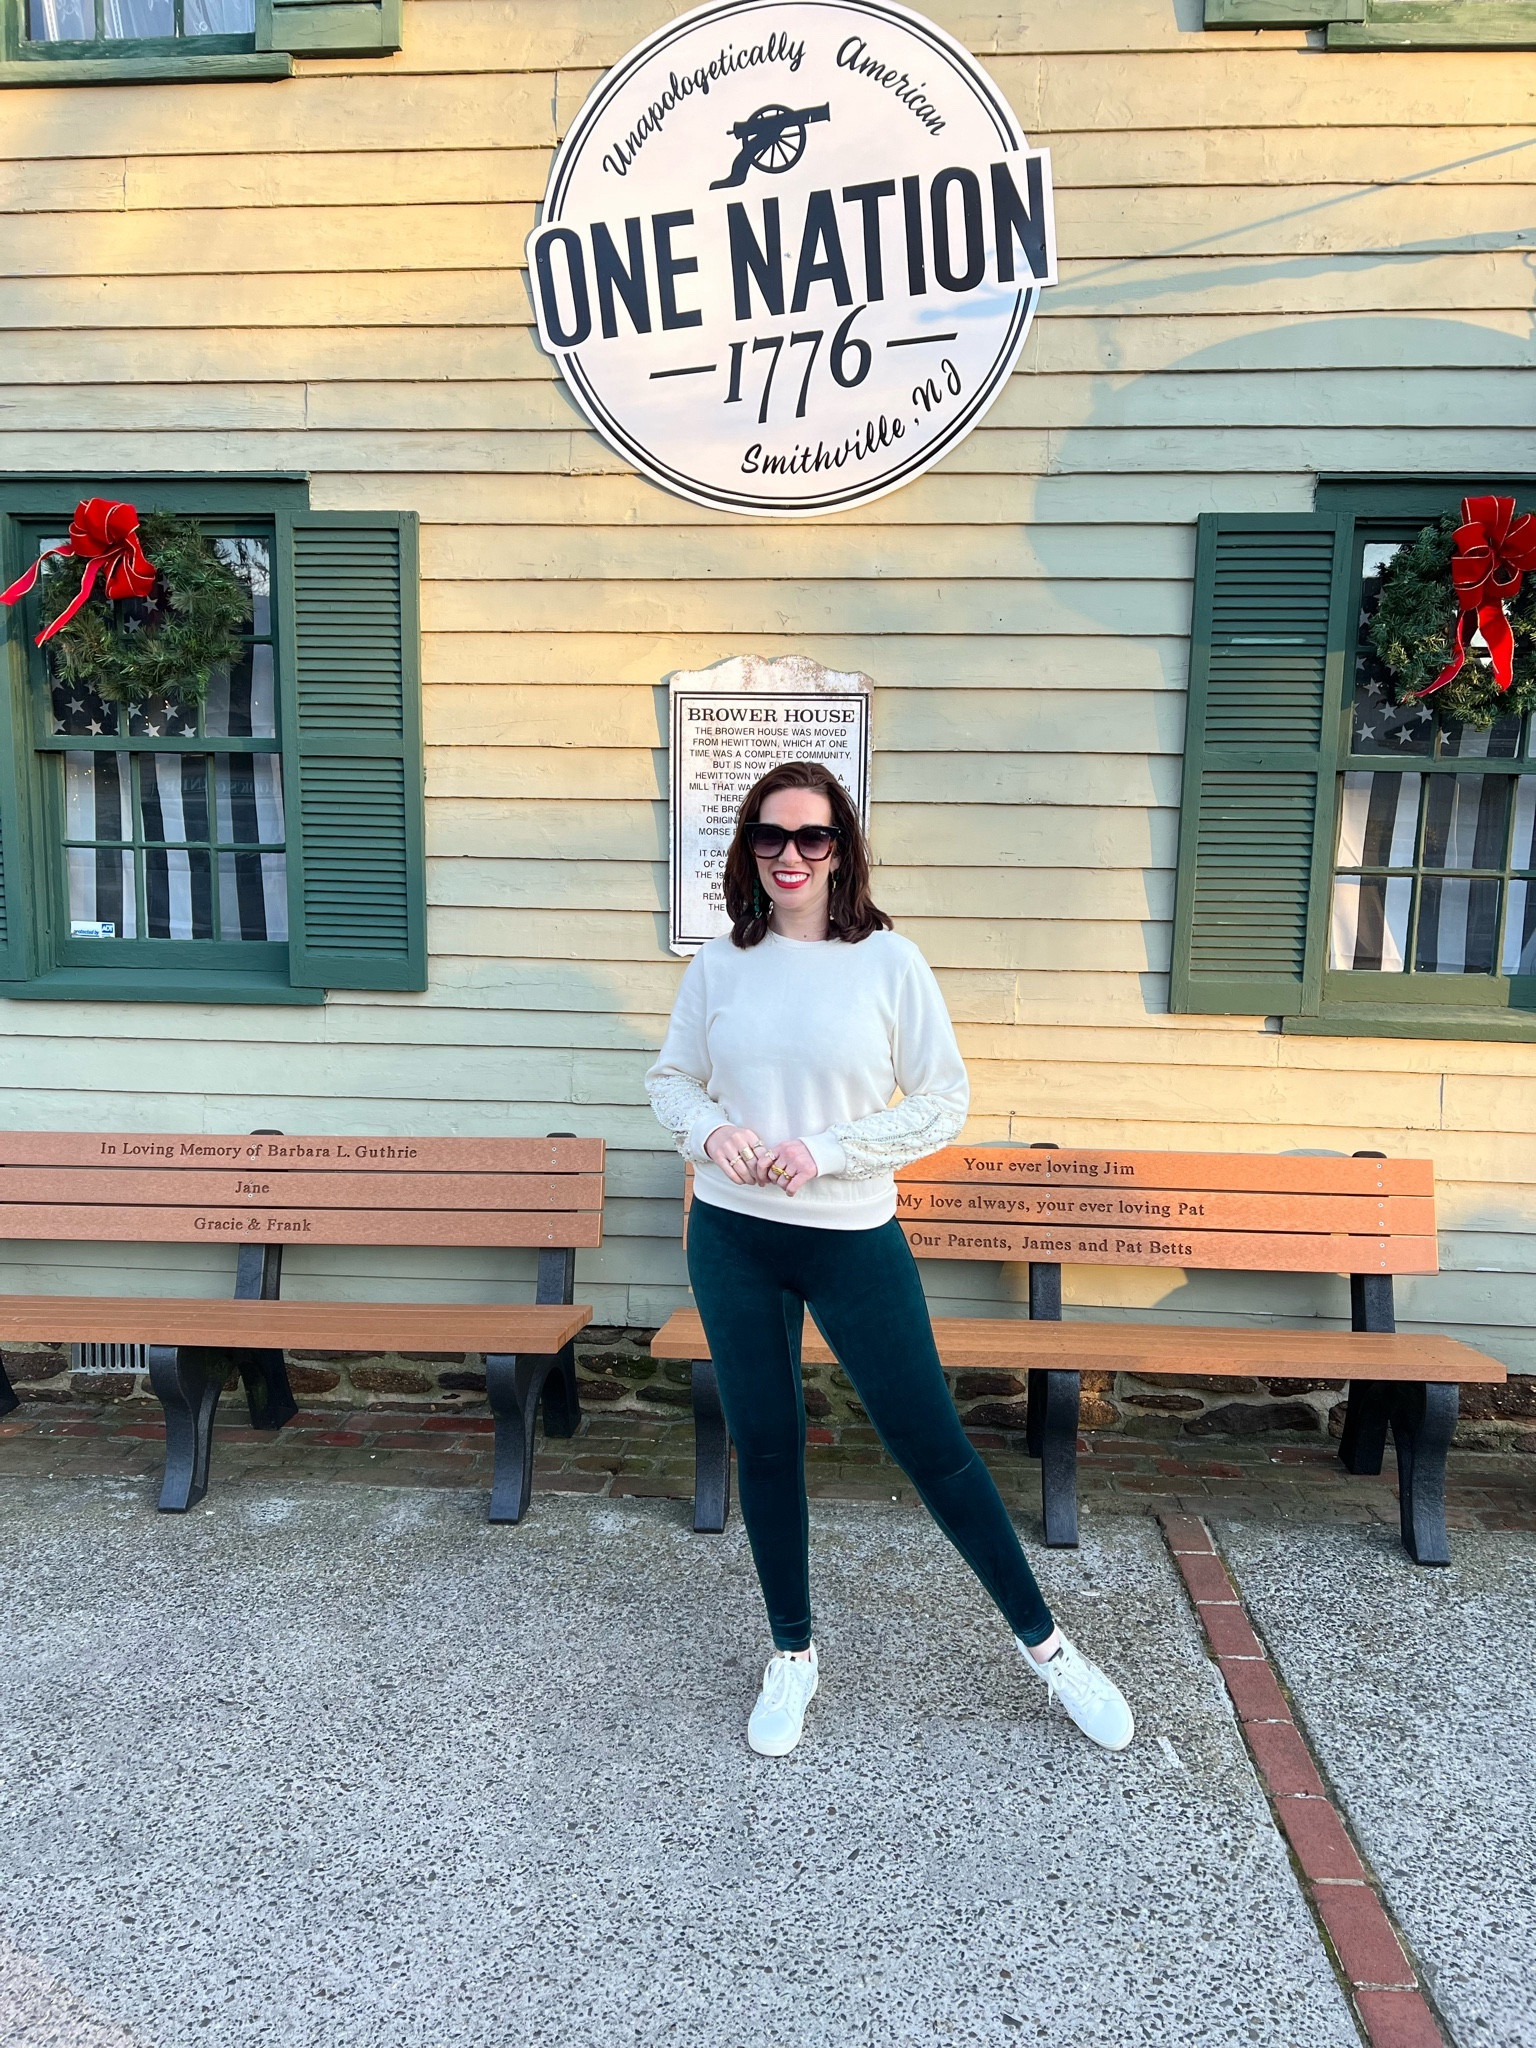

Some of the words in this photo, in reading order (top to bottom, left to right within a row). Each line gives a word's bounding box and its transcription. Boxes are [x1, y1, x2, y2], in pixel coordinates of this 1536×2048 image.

[602, 31, 806, 177] Unapologetically
[835, 36, 945, 136] American
[535, 208, 703, 347] ONE
[727, 156, 1049, 321] NATION
[724, 304, 872, 424] 1776
[688, 708, 778, 722] BROWER
[784, 709, 855, 723] HOUSE
[695, 727, 712, 735] THE
[715, 728, 755, 736] BROWER
[757, 728, 789, 736] HOUSE
[791, 729, 812, 737] WAS
[814, 729, 847, 737] MOVED
[692, 738, 719, 746] FROM
[815, 740, 826, 748] AT
[828, 740, 848, 748] ONE
[690, 749, 710, 757] TIME
[712, 750, 733, 758] WAS
[735, 750, 742, 758] A
[744, 750, 793, 759] COMPLETE
[795, 751, 852, 760] COMMUNITY,
[712, 761, 731, 769] BUT
[733, 761, 742, 769] IS
[744, 761, 766, 769] NOW
[695, 772, 751, 780] HEWITTOWN
[712, 783, 735, 791] THAT
[714, 794, 744, 802] THERE
[706, 816, 736, 824] ORIGIN
[699, 849, 707, 857] IT
[703, 860, 715, 868] OF
[100, 1142, 116, 1155] In
[123, 1143, 175, 1158] Loving
[180, 1143, 241, 1160] Memory
[246, 1144, 262, 1158] of
[267, 1144, 331, 1158] Barbara
[336, 1145, 351, 1158] L.
[354, 1145, 418, 1159] Guthrie
[963, 1157, 1004, 1172] Your
[1008, 1160, 1042, 1173] ever
[1046, 1159, 1099, 1177] loving
[1103, 1160, 1135, 1176] Jim
[235, 1181, 270, 1195] Jane
[896, 1193, 923, 1210] My
[929, 1194, 962, 1209] love
[968, 1196, 1031, 1214] always,
[1036, 1199, 1075, 1215] your
[1079, 1201, 1113, 1214] ever
[1119, 1200, 1171, 1218] loving
[1178, 1201, 1205, 1217] Pat
[193, 1217, 243, 1231] Gracie
[247, 1218, 261, 1231] &
[266, 1218, 312, 1232] Frank
[909, 1232, 942, 1248] Our
[947, 1233, 1012, 1252] Parents,
[1022, 1235, 1072, 1252] James
[1078, 1238, 1109, 1253] and
[1115, 1238, 1143, 1254] Pat
[1149, 1240, 1193, 1256] Betts
